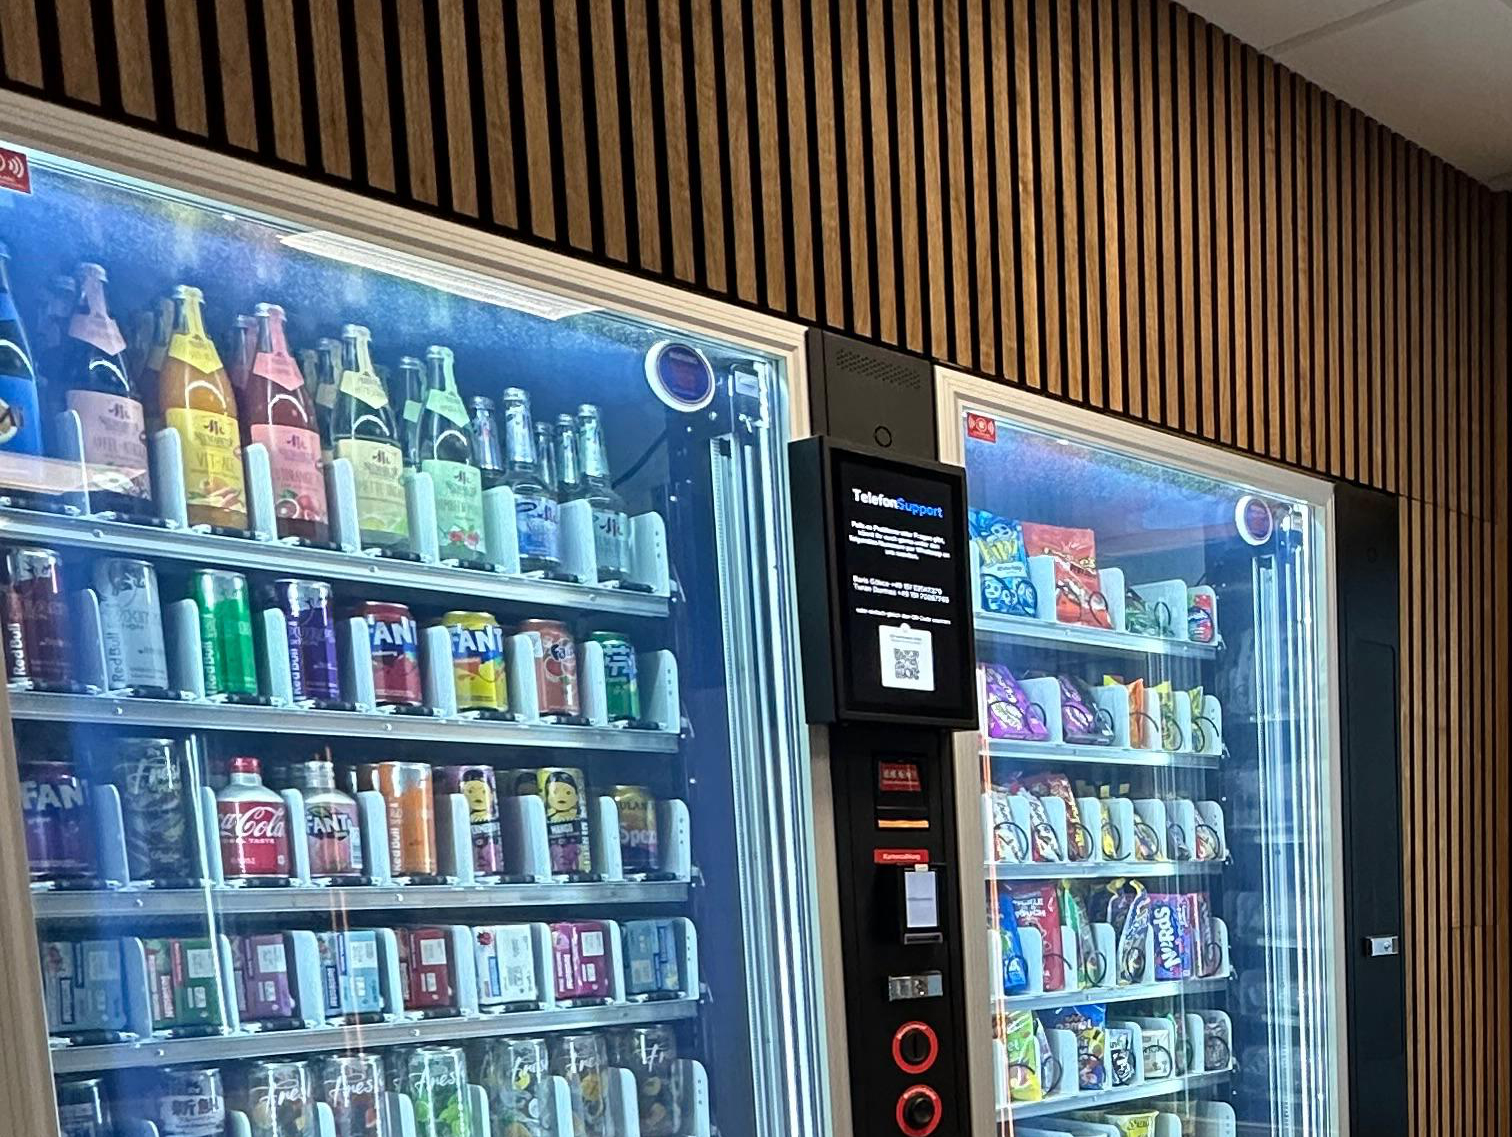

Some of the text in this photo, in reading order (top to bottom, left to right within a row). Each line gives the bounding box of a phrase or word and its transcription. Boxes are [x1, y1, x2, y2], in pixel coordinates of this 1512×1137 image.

[8, 622, 26, 676] Red Bull
[106, 632, 125, 682] Red Bull
